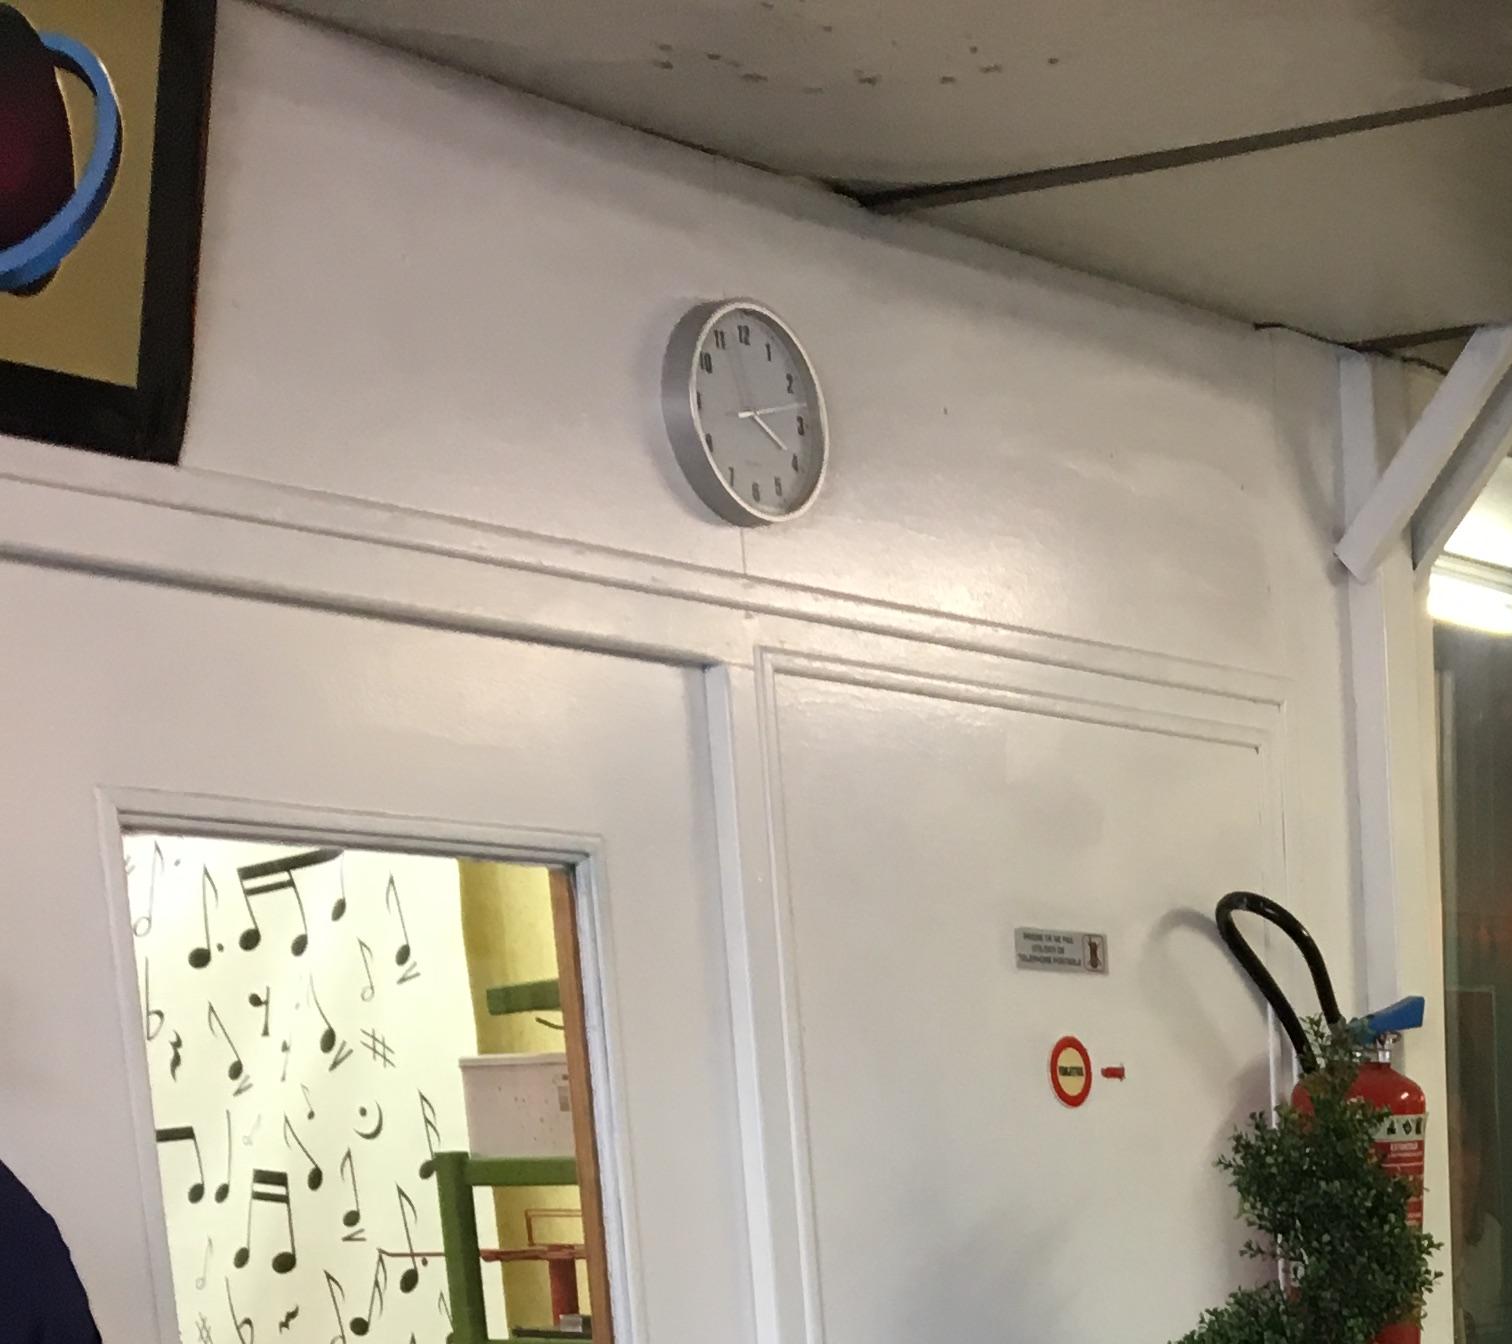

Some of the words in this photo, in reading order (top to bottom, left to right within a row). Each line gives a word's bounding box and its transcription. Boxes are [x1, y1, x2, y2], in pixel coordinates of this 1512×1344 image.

[714, 329, 726, 350] 11
[737, 325, 751, 346] 12
[700, 351, 712, 374] 10
[765, 343, 772, 362] 1
[785, 373, 794, 394] 2
[796, 416, 805, 436] 3
[791, 453, 799, 472] 4
[728, 466, 736, 487] 7
[774, 476, 783, 496] 5
[752, 482, 760, 502] 6
